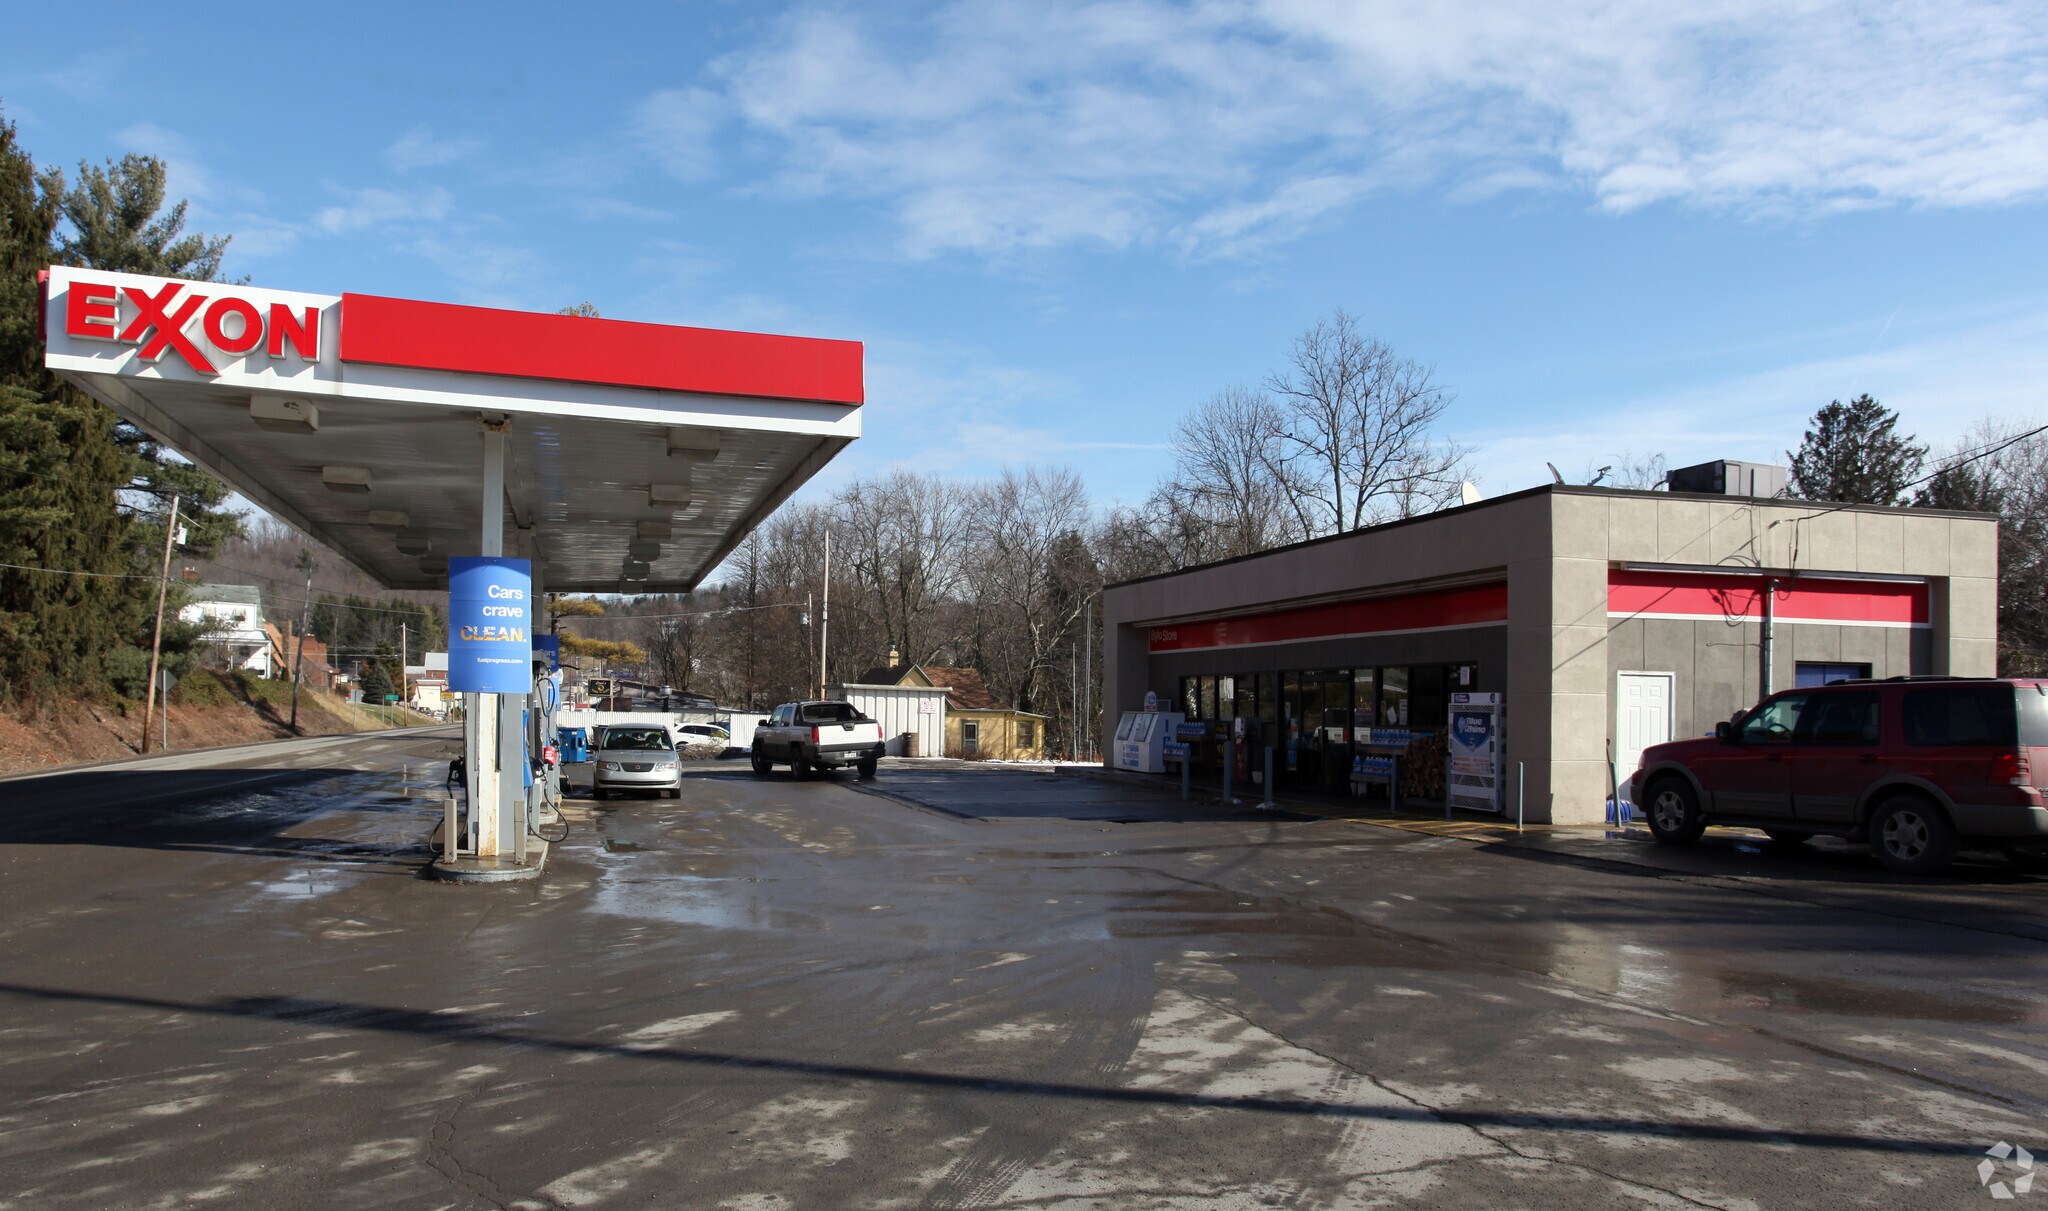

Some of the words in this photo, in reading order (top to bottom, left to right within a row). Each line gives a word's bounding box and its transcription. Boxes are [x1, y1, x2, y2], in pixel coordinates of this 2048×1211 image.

[65, 281, 322, 376] EXXON
[488, 584, 523, 599] Cars
[482, 605, 523, 618] crave
[460, 625, 528, 643] CLEAN.
[1466, 717, 1483, 726] Blue
